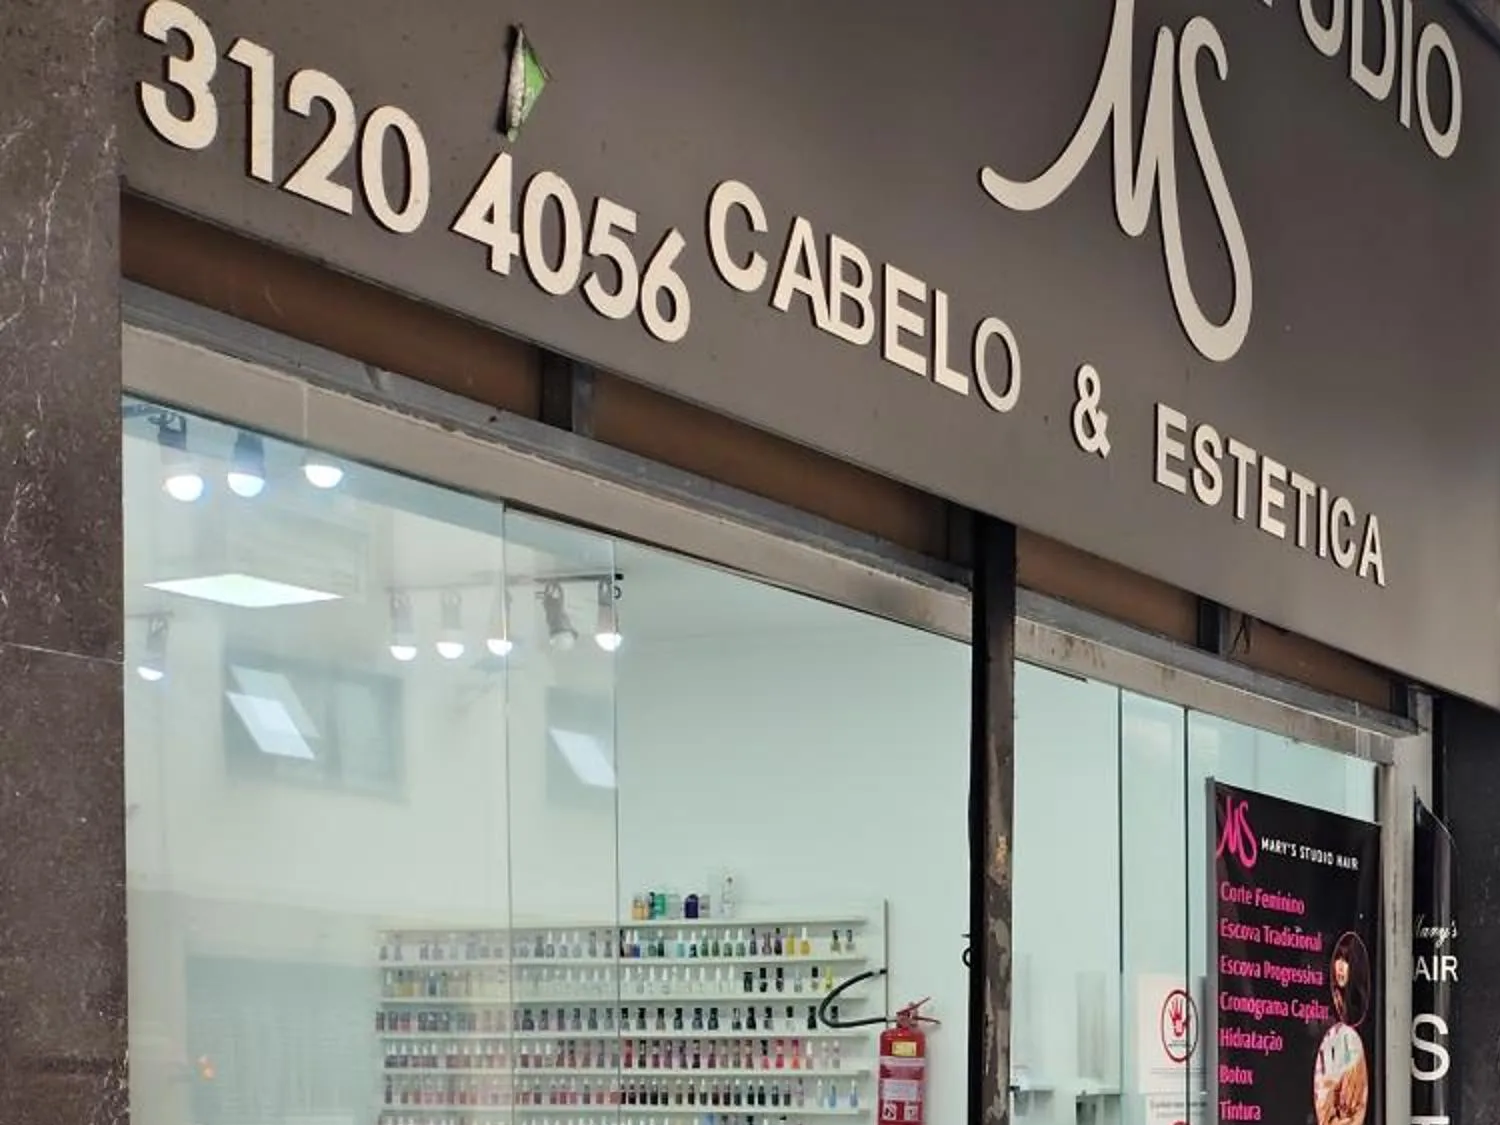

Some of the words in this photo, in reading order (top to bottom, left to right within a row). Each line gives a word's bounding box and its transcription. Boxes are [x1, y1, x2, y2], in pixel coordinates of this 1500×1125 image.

[1263, 0, 1462, 158] DIO
[140, 0, 431, 234] 3120
[451, 152, 692, 343] 4056
[708, 179, 1022, 413] CABELO
[1071, 363, 1112, 459] &
[1155, 402, 1386, 587] ESTETICA
[1261, 836, 1297, 857] MARY'S
[1299, 845, 1335, 865] STUDIO
[1335, 855, 1360, 871] HAIR
[1220, 881, 1253, 905] Corte
[1254, 887, 1305, 915] Feminino
[1220, 917, 1261, 943] Escova
[1262, 925, 1322, 952] Tradicional
[1220, 955, 1261, 979] Escova
[1263, 961, 1323, 988] Progressiva
[1413, 954, 1459, 982] AIR
[1220, 991, 1289, 1021] Cronograma
[1291, 999, 1329, 1025] Capilar
[1220, 1027, 1283, 1056] Hidratação
[1220, 1064, 1253, 1085] Botox
[1219, 1099, 1261, 1121] Tintura
